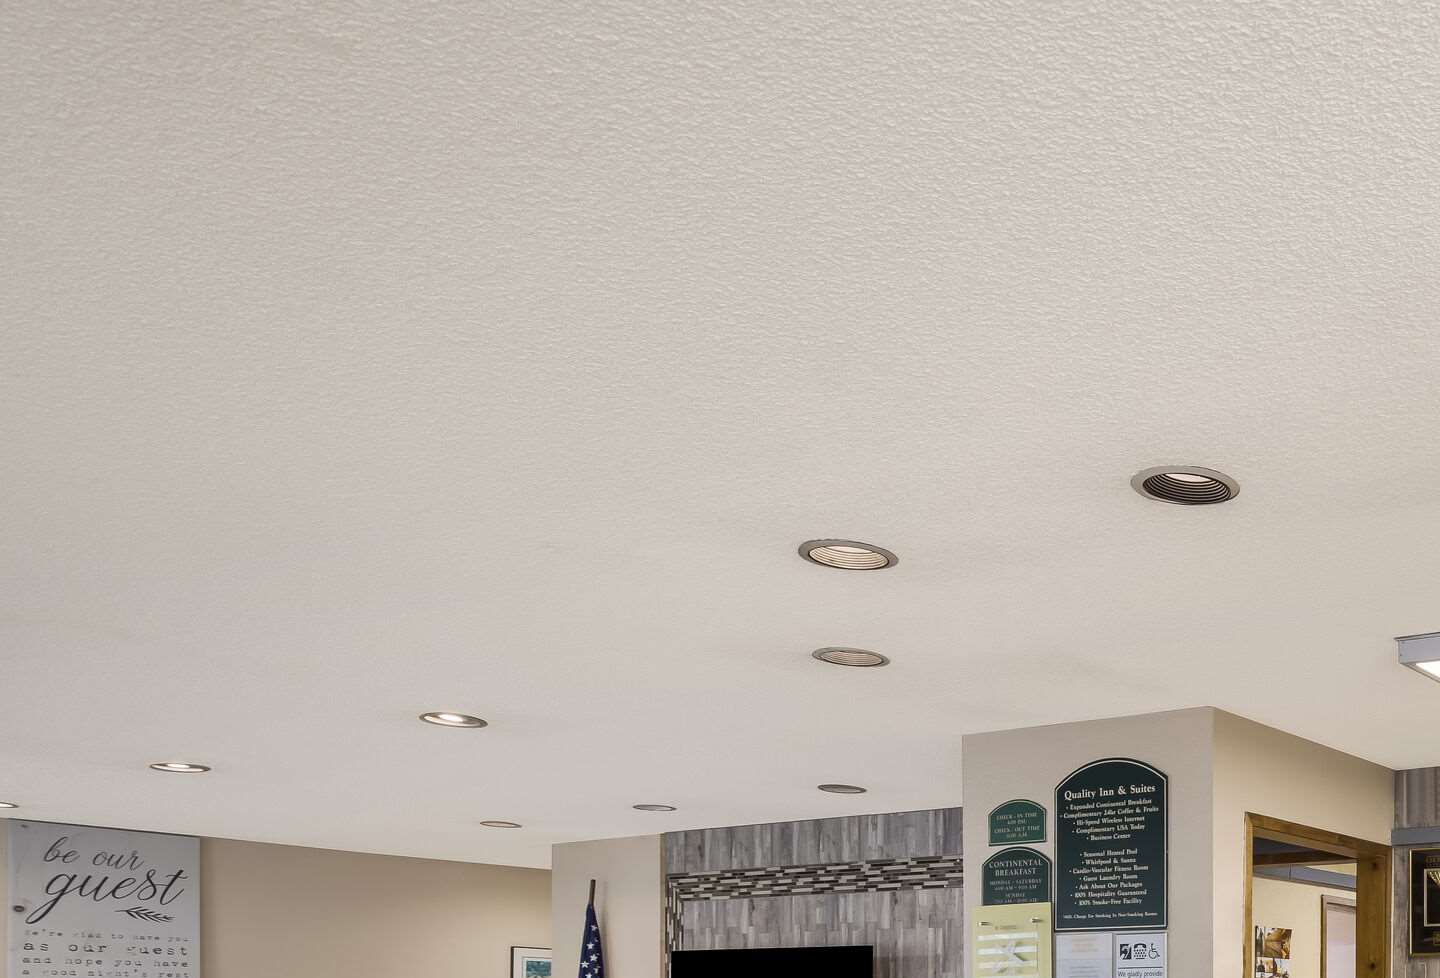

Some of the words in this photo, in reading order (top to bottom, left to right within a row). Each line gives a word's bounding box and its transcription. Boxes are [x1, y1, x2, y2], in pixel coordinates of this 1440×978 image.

[1064, 789, 1096, 800] Quality
[1100, 788, 1114, 796] Inn
[1118, 786, 1126, 794] &
[1130, 784, 1155, 794] Suites
[44, 836, 80, 863] be
[92, 851, 144, 871] our
[989, 859, 1043, 869] CONTINENTAL
[995, 868, 1036, 876] BREAKFAST
[25, 868, 188, 924] guest
[23, 943, 49, 952] as
[68, 944, 108, 953] our
